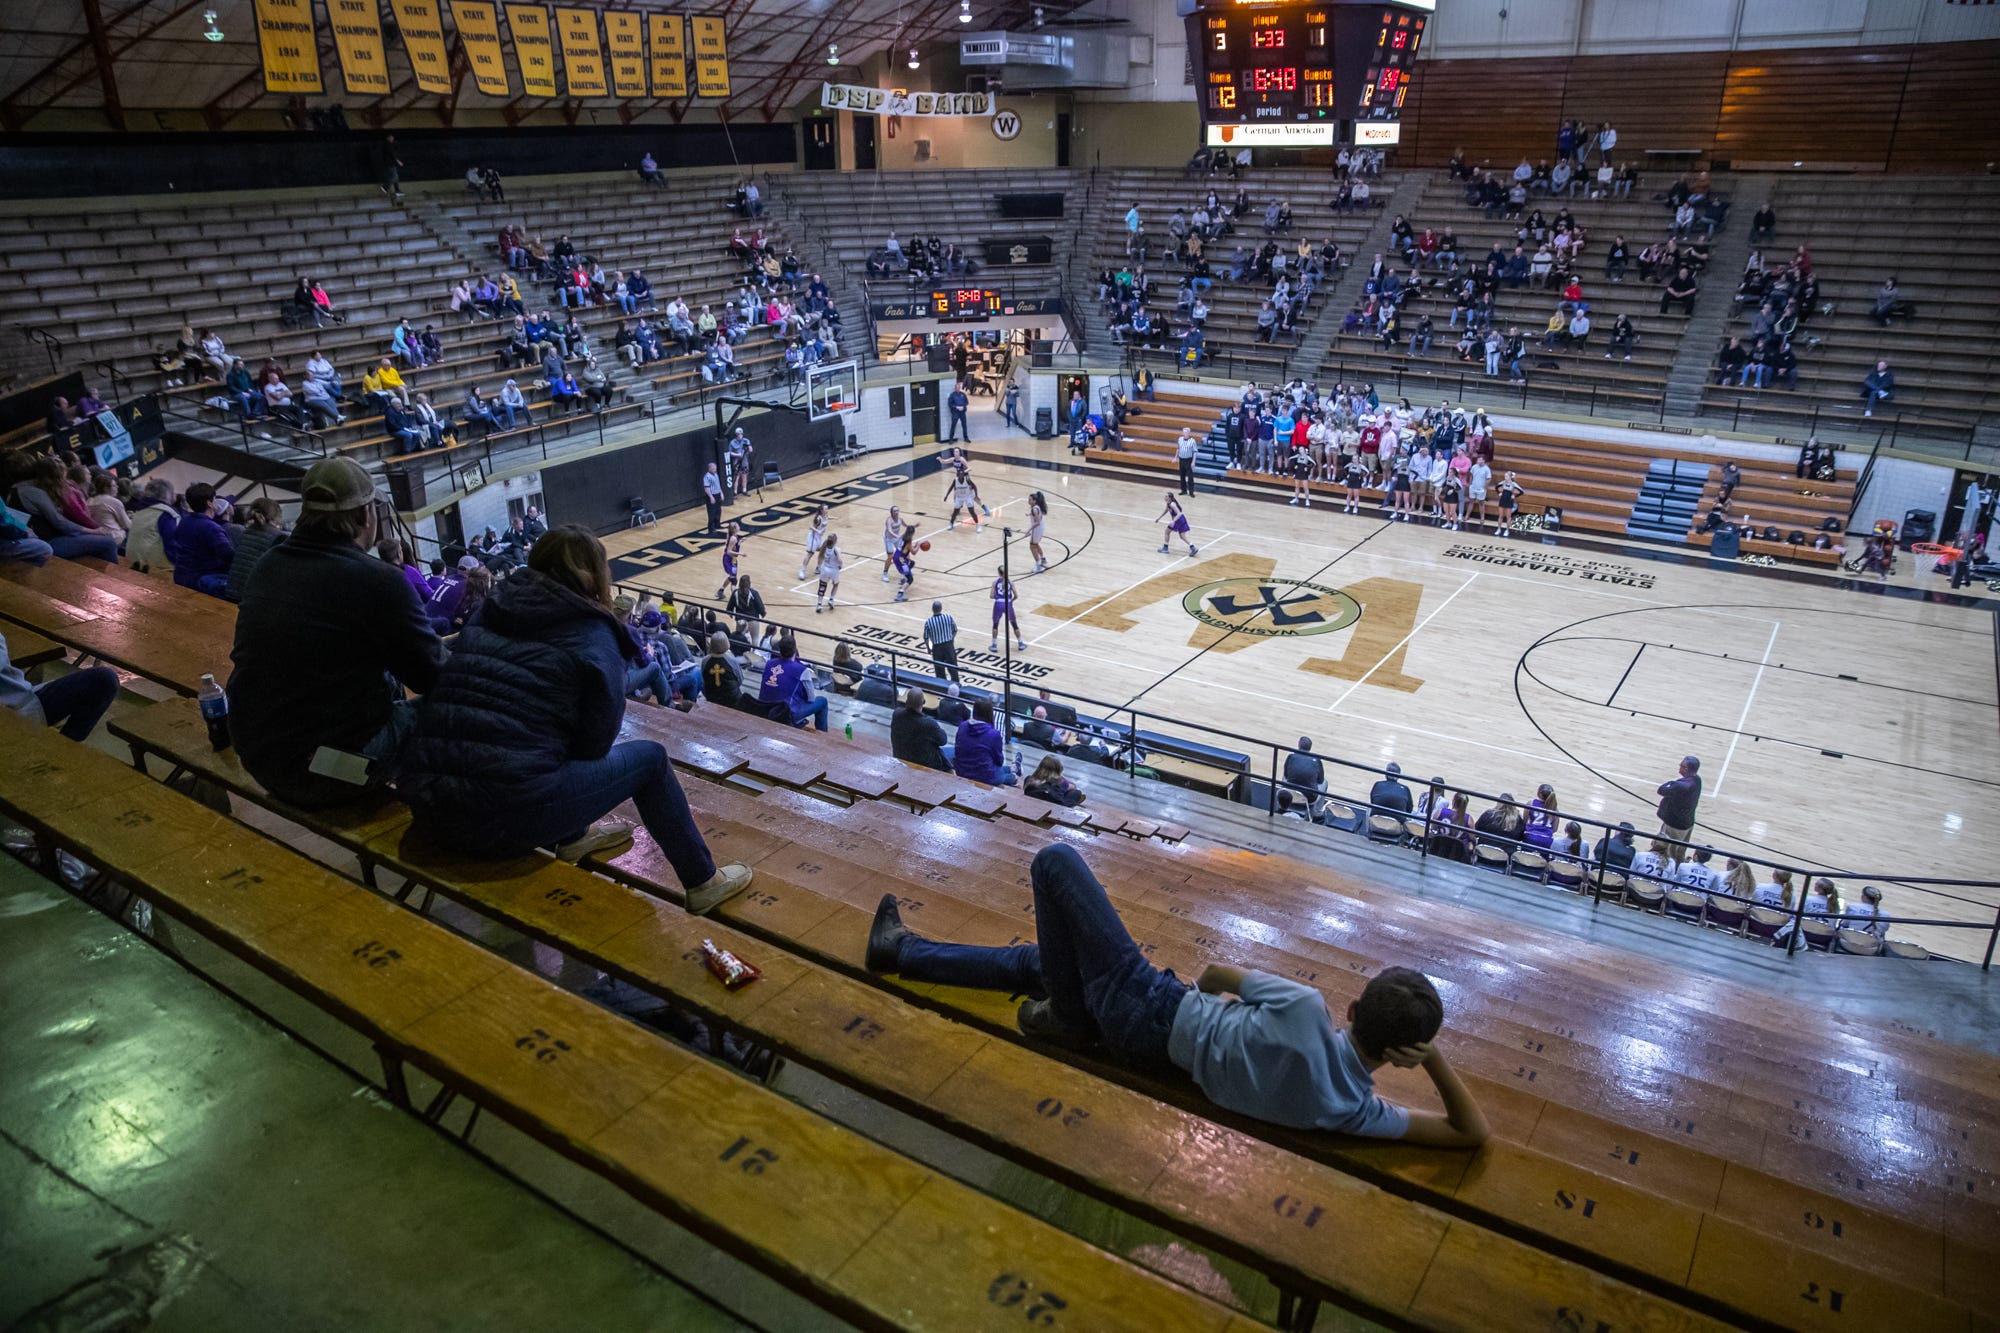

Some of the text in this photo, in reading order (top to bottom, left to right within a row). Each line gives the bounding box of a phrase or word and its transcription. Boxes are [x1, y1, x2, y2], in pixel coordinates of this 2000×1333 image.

[340, 1, 365, 12] STATE
[403, 6, 428, 16] STATE
[462, 10, 486, 20] STATE
[517, 14, 539, 24] STATE
[262, 20, 311, 33] CHAMPION
[1208, 18, 1227, 29] fouls
[1253, 14, 1279, 26] player
[335, 25, 378, 37] CHAMPION
[401, 28, 441, 40] CHAMPION
[570, 32, 589, 40] STATE
[460, 32, 497, 43] CHAMPION
[516, 35, 549, 45] CHAMPION
[616, 35, 634, 43] STATE
[658, 36, 676, 45] STATE
[702, 38, 718, 46] STATE
[1215, 33, 1226, 50] 3
[565, 48, 599, 57] CHAMPION
[612, 50, 642, 59] CHAMPION
[653, 51, 683, 60] CHAMPION
[697, 53, 725, 61] CHAMPION
[1209, 68, 1333, 90] Home 6:48 Guests
[828, 87, 989, 114] PEP BAND
[1219, 86, 1236, 108] 12
[1315, 84, 1334, 106] 11
[1256, 106, 1281, 117] period
[997, 117, 1016, 133] W
[884, 304, 914, 316] Gate 1
[937, 297, 1000, 311] 12 11
[1016, 300, 1045, 311] Gate 1
[1442, 549, 1655, 589] STATE CHAMPIONS
[1260, 577, 1339, 596] HATCHETS
[1191, 609, 1300, 636] WASHINGTON
[847, 624, 919, 647] STATE
[515, 1028, 571, 1062] 22
[1036, 1097, 1090, 1128] 20
[718, 1136, 780, 1175] 21
[1553, 1188, 1596, 1220] 18
[1273, 1194, 1323, 1229] 19
[988, 1272, 1068, 1326] 20
